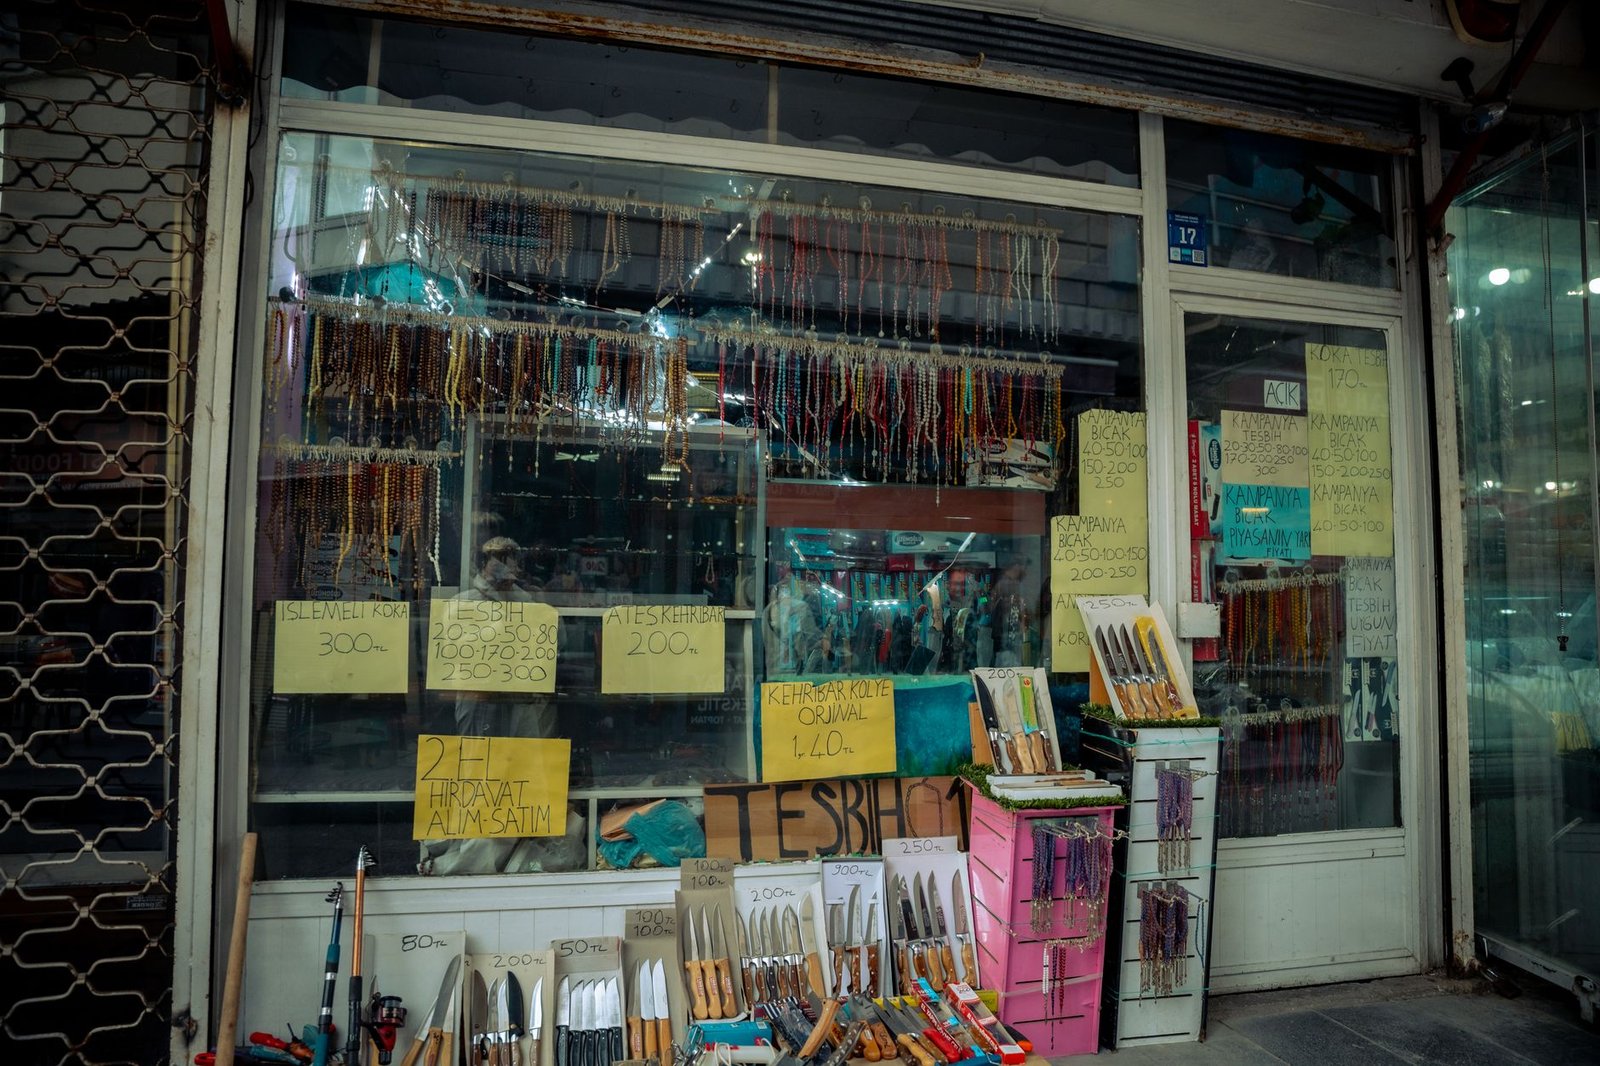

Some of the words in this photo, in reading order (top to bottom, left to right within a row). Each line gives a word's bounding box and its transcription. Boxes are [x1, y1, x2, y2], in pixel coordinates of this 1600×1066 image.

[1179, 226, 1198, 245] 17
[1310, 343, 1352, 365] KOKA
[1265, 381, 1299, 406] AÇIK
[1079, 408, 1146, 427] KAMPANYA
[1232, 413, 1299, 432] KAMPANYA
[1310, 414, 1379, 433] KAMPANYA
[1094, 477, 1125, 489] 250
[1226, 485, 1302, 508] KAMPANYA
[1312, 483, 1379, 503] KAMPANYA
[1056, 515, 1127, 534] KAMPANYA
[1345, 557, 1392, 571] KAMPANYA
[372, 603, 408, 619] KOKA
[1350, 615, 1395, 631] UYGUN
[850, 679, 890, 700] KOLYE
[457, 737, 501, 781] EL
[430, 780, 530, 808] HIRDAVAT
